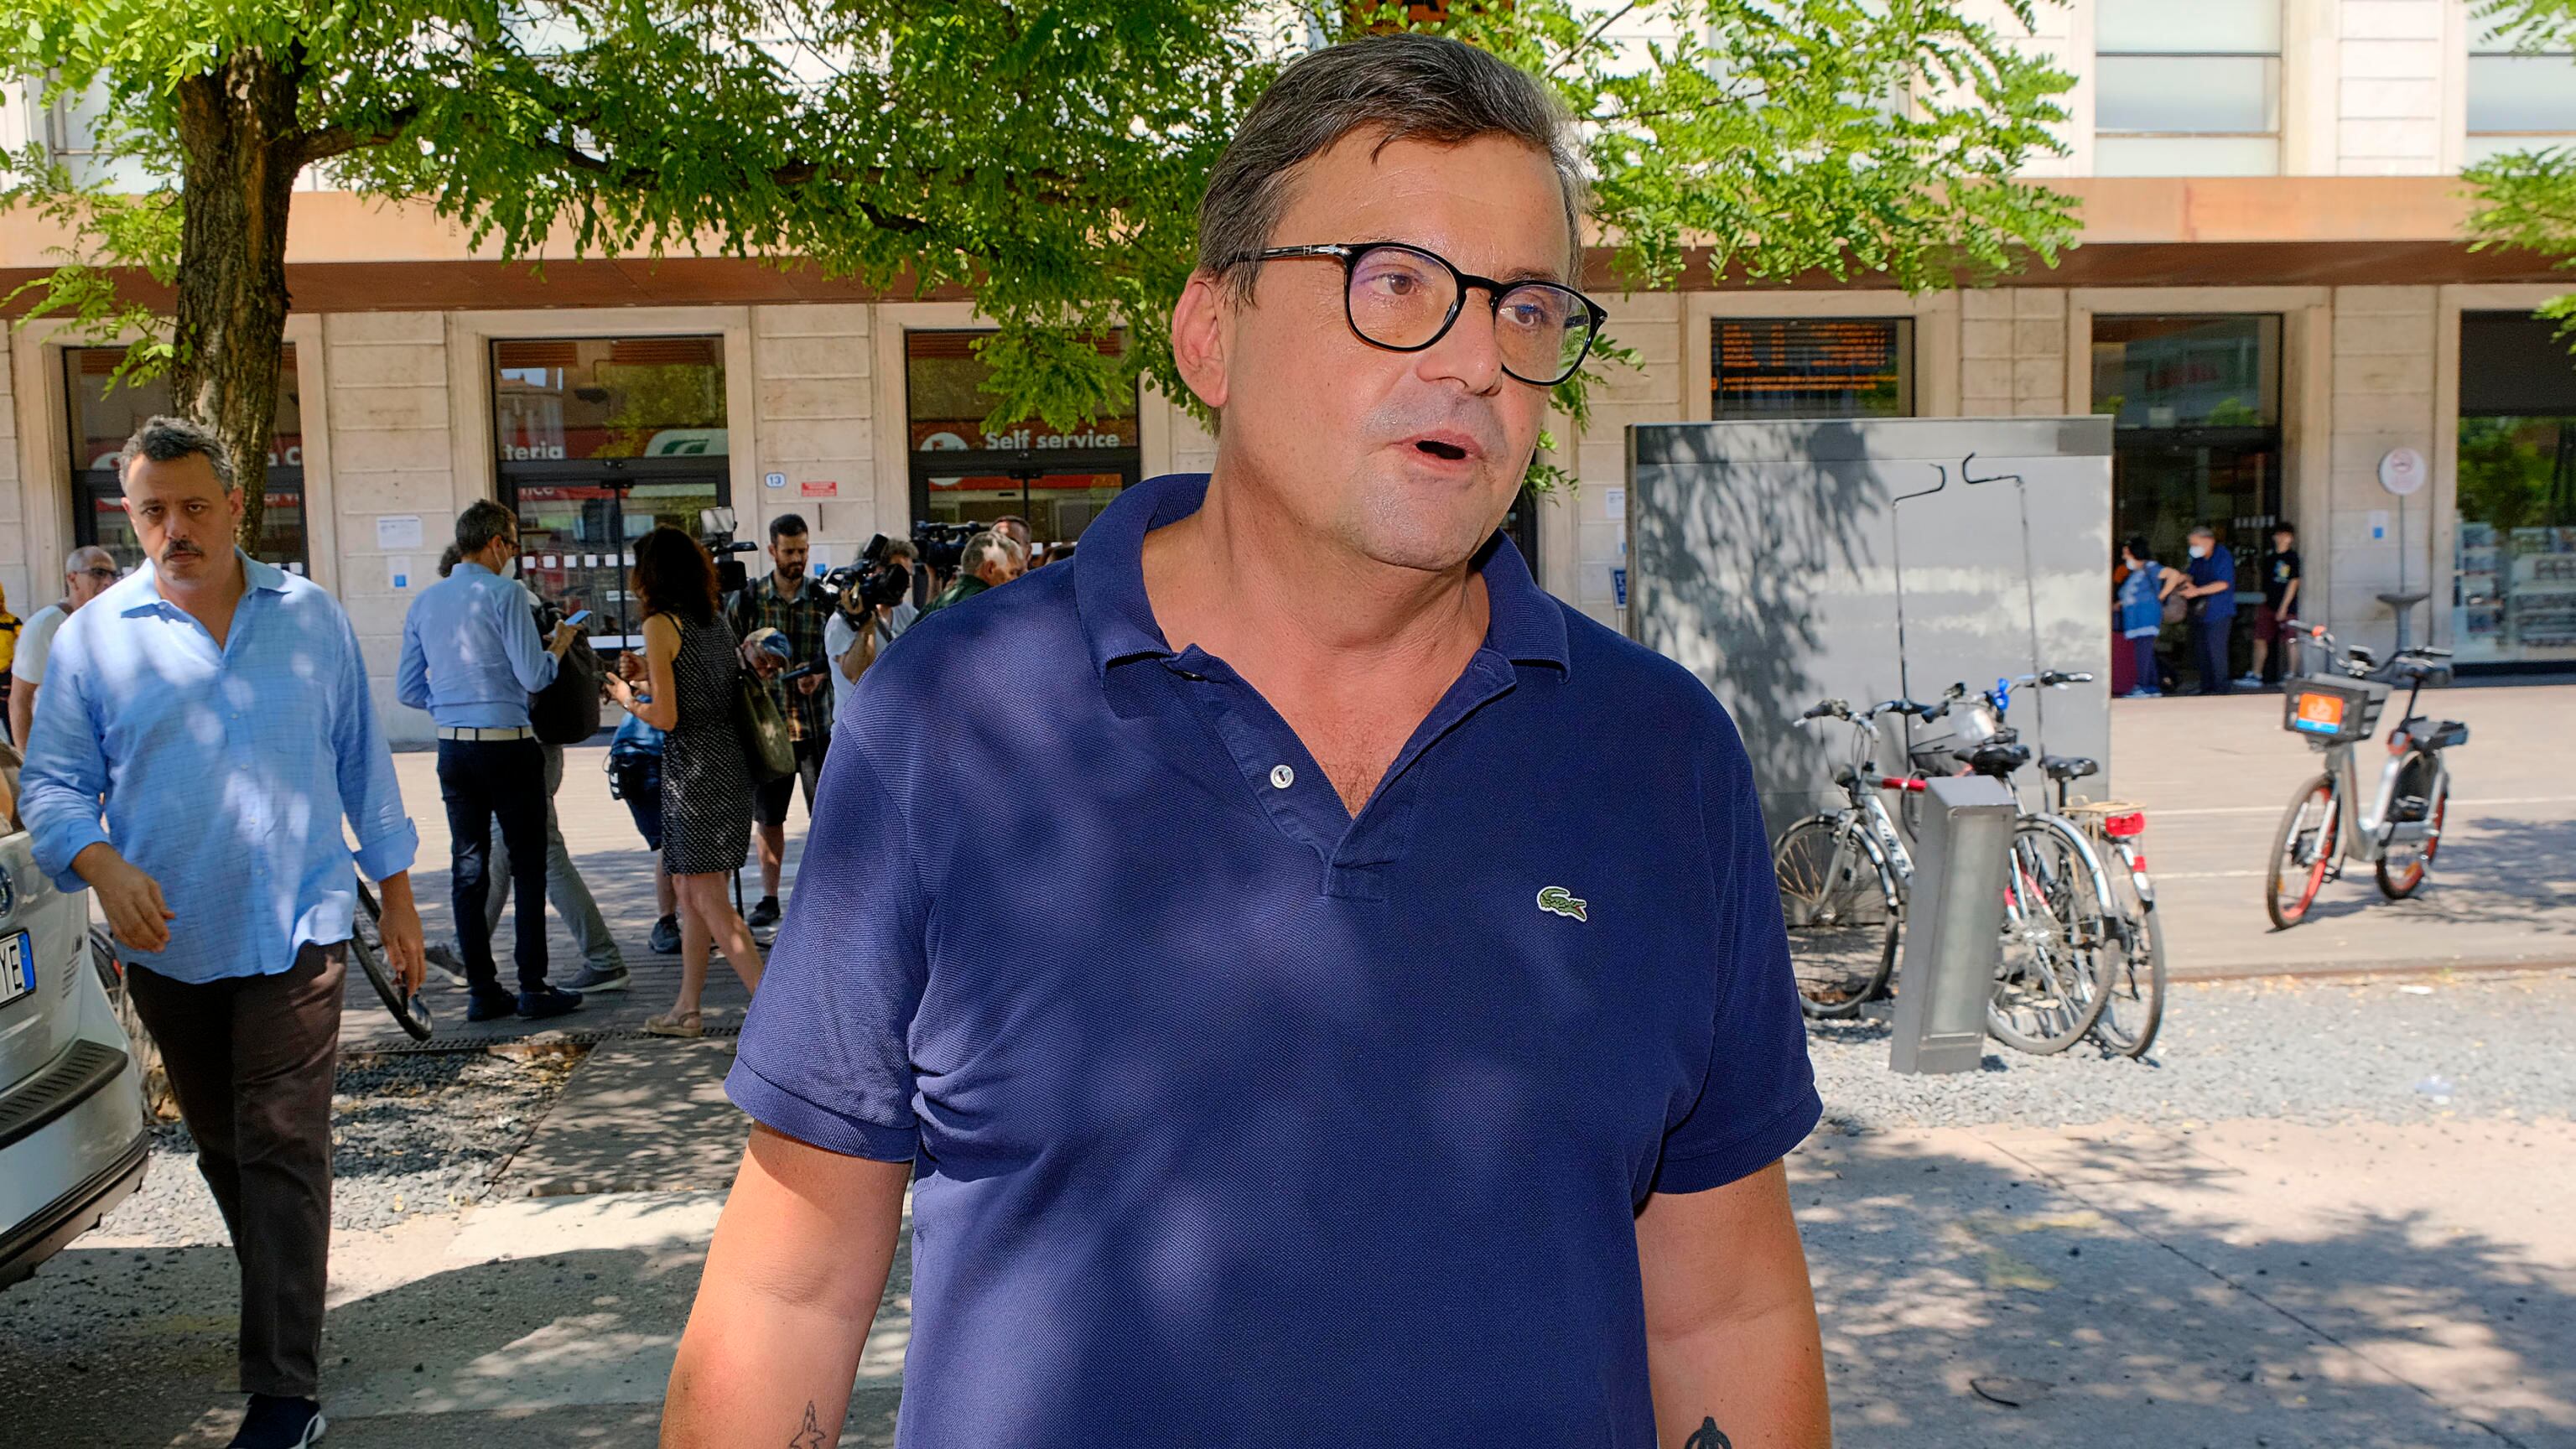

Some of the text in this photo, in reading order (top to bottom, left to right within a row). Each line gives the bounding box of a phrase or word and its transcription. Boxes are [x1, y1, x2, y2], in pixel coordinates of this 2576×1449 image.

[985, 428, 1119, 449] Self service
[505, 441, 564, 460] teria
